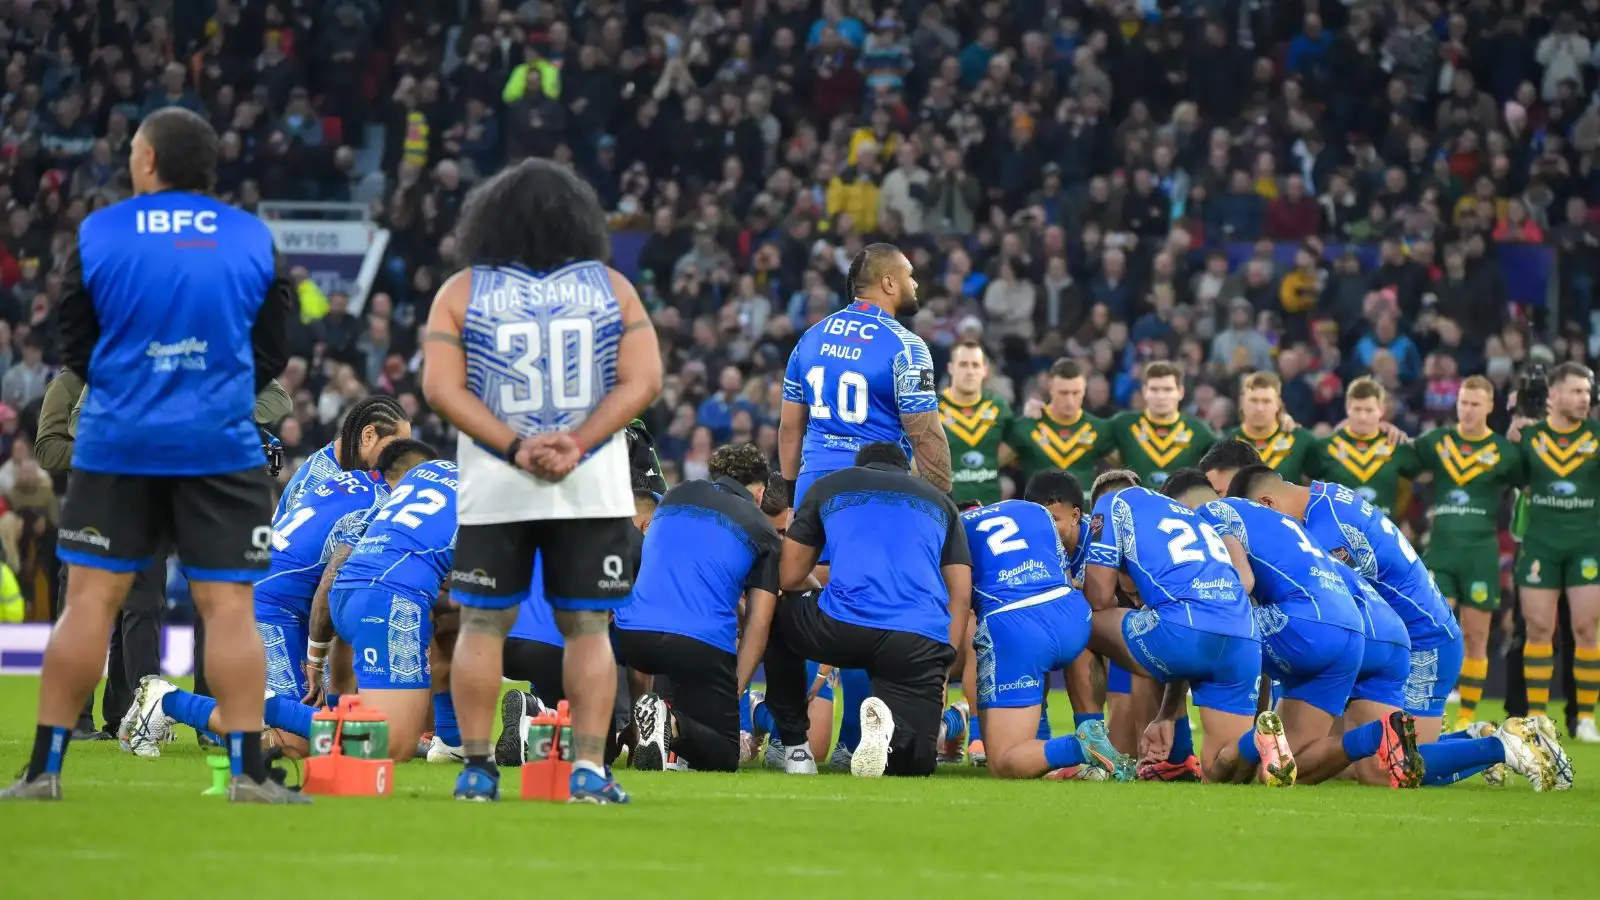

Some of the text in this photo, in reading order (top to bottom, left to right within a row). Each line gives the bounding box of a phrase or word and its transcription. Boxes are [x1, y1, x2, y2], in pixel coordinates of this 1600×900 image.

[135, 209, 218, 234] IBFC
[482, 283, 606, 317] TOA SAMOA
[823, 318, 879, 340] IBFC
[820, 343, 862, 361] PAULO
[497, 318, 592, 414] 30
[805, 366, 869, 425] 10
[332, 471, 369, 494] BFC
[411, 469, 459, 491] TUILAG
[375, 484, 449, 530] 22
[964, 506, 1001, 520] MAY
[1532, 494, 1595, 511] Gallagher
[975, 515, 1029, 557] 2
[1157, 517, 1235, 566] 26
[603, 555, 623, 580] Q
[996, 558, 1045, 583] Beautiful
[1191, 577, 1234, 590] Beautiful
[363, 647, 378, 666] Q
[998, 675, 1040, 694] pacificezy
[315, 732, 333, 754] G
[376, 765, 386, 794] G
